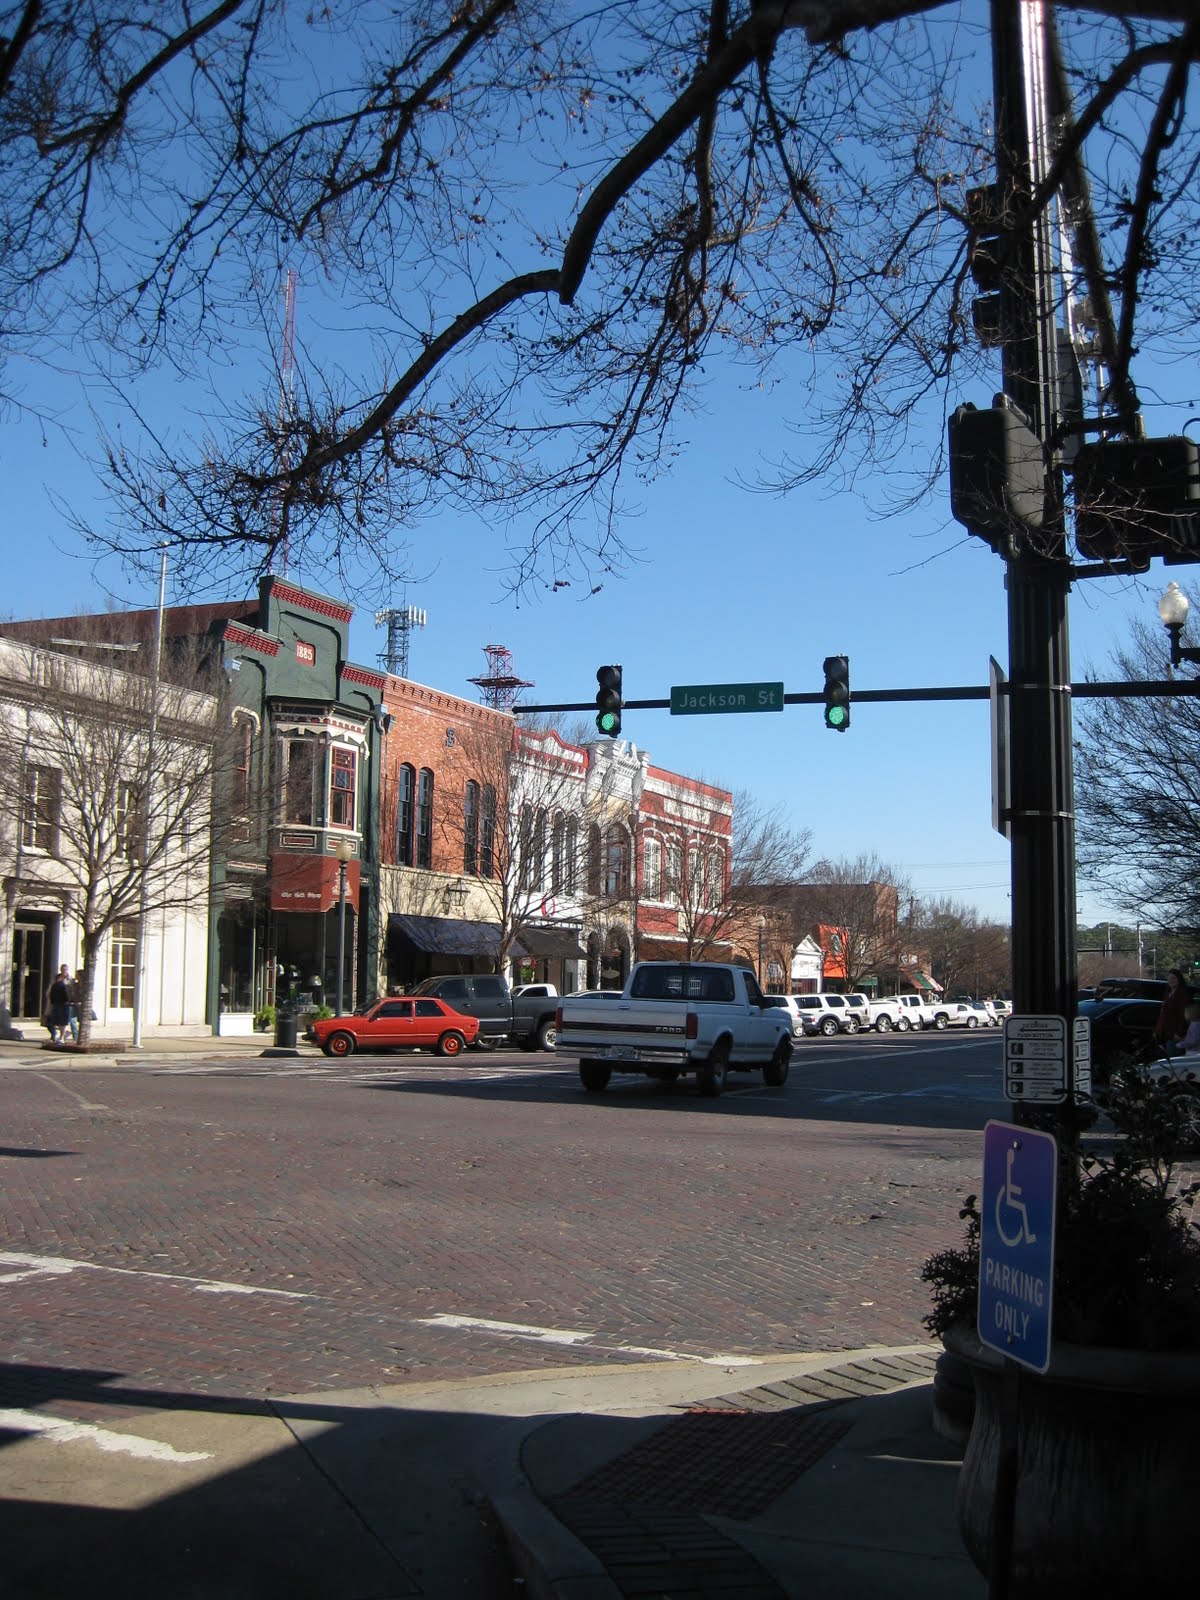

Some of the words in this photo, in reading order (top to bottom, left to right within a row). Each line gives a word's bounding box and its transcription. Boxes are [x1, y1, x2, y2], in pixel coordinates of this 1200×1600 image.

[296, 644, 312, 660] 1885
[679, 693, 746, 708] Jackson
[758, 690, 775, 705] St
[985, 1257, 1043, 1307] PARKING
[995, 1300, 1029, 1342] ONLY
